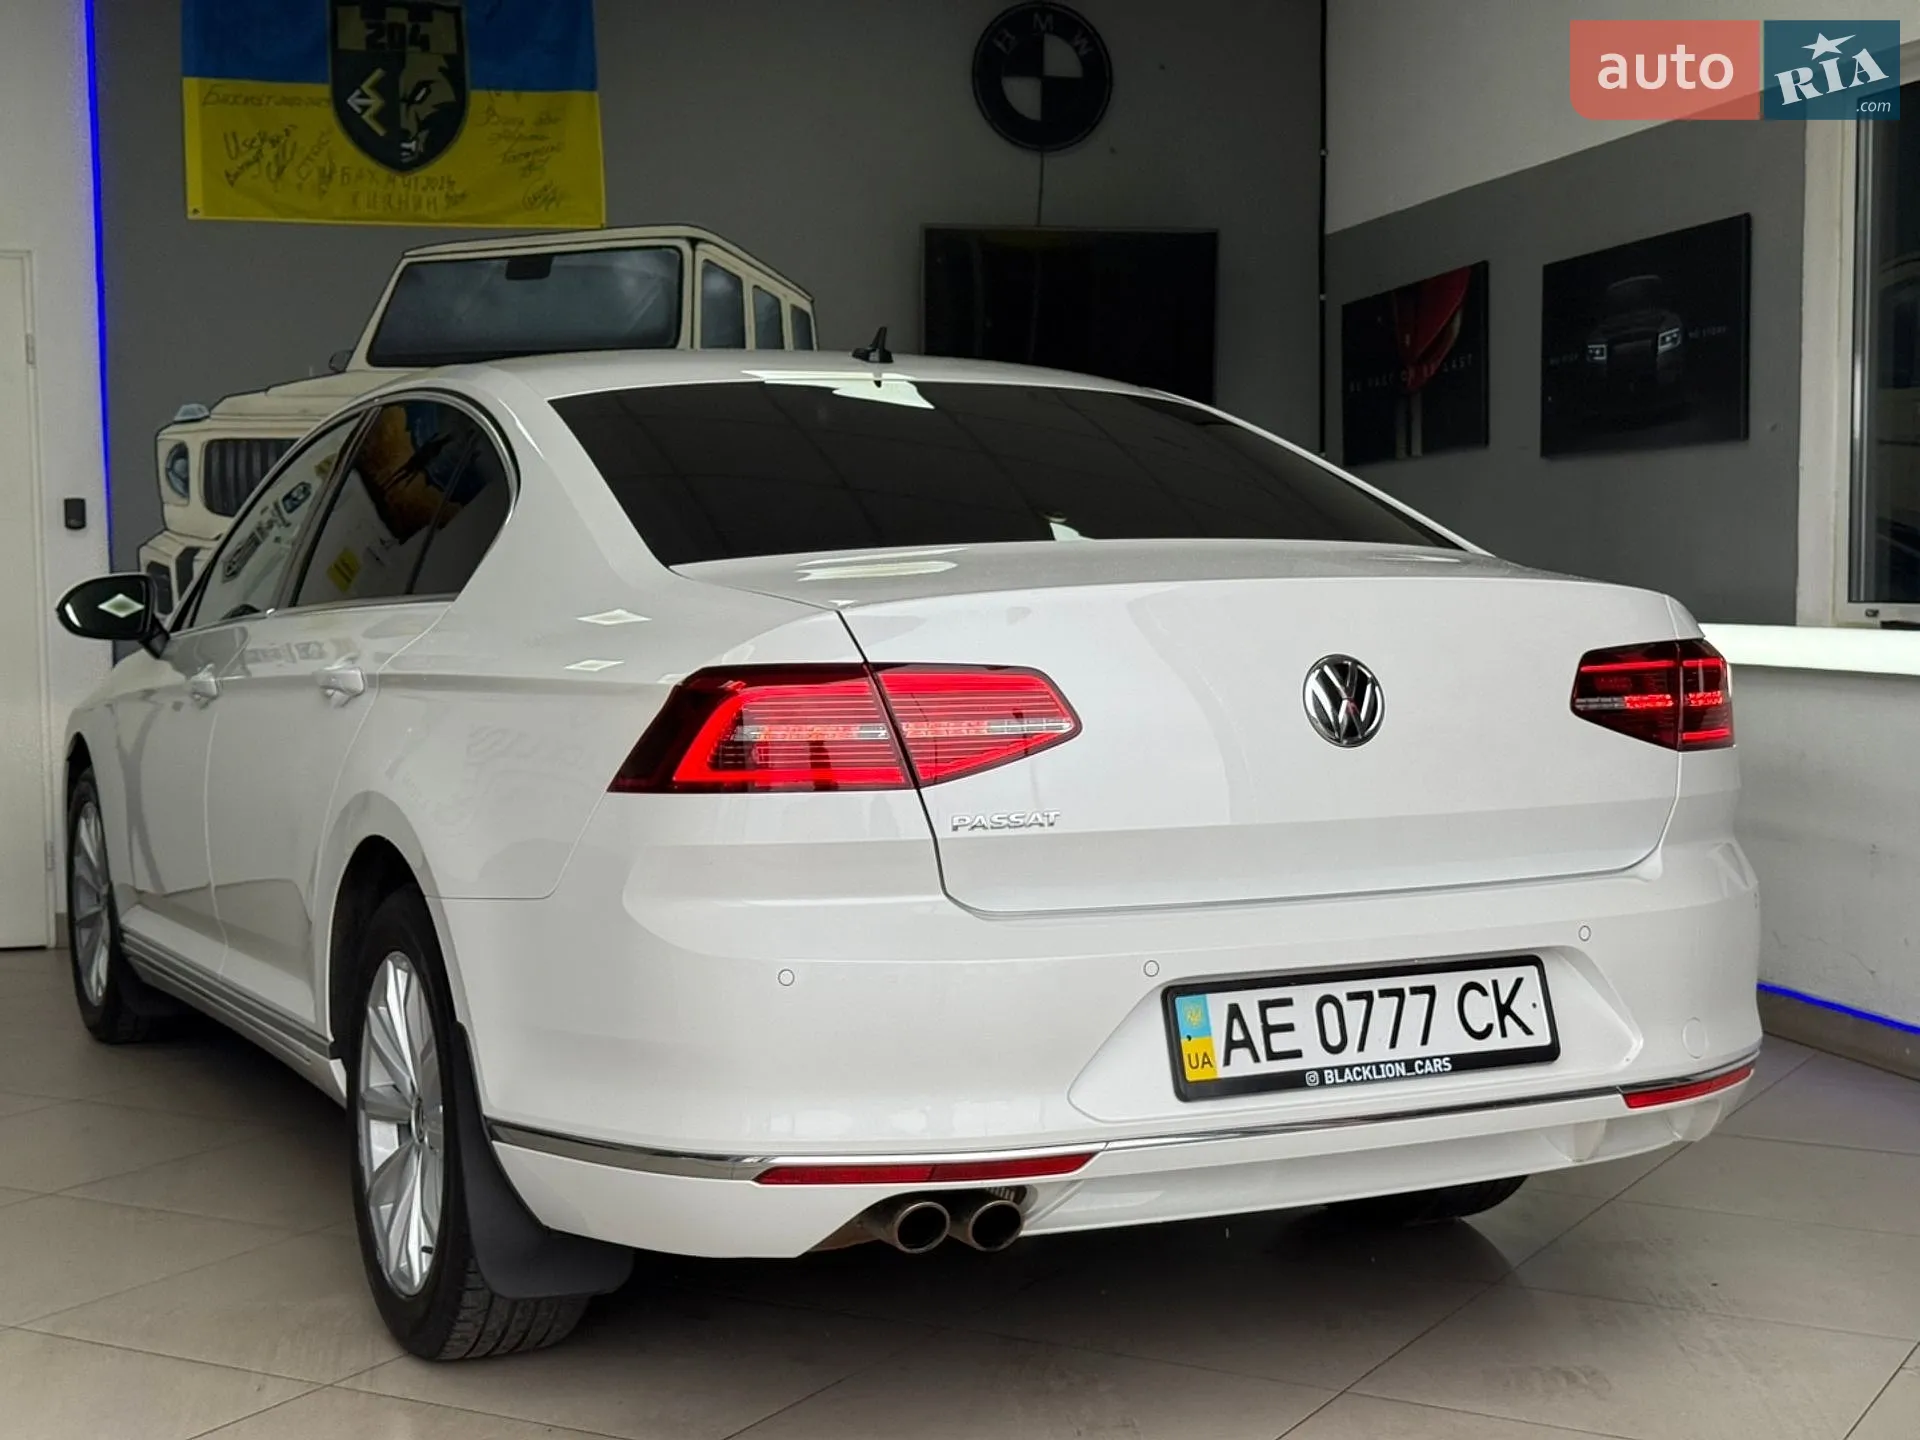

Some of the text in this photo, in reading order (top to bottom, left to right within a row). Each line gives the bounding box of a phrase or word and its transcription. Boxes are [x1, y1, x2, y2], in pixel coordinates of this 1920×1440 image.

[365, 21, 430, 52] 204
[993, 12, 1094, 57] BMW
[951, 810, 1060, 831] PASSAT
[1222, 976, 1534, 1067] AE 0777 CK
[1187, 1052, 1213, 1071] UA
[1324, 1056, 1453, 1085] BLACKLION_CARS
